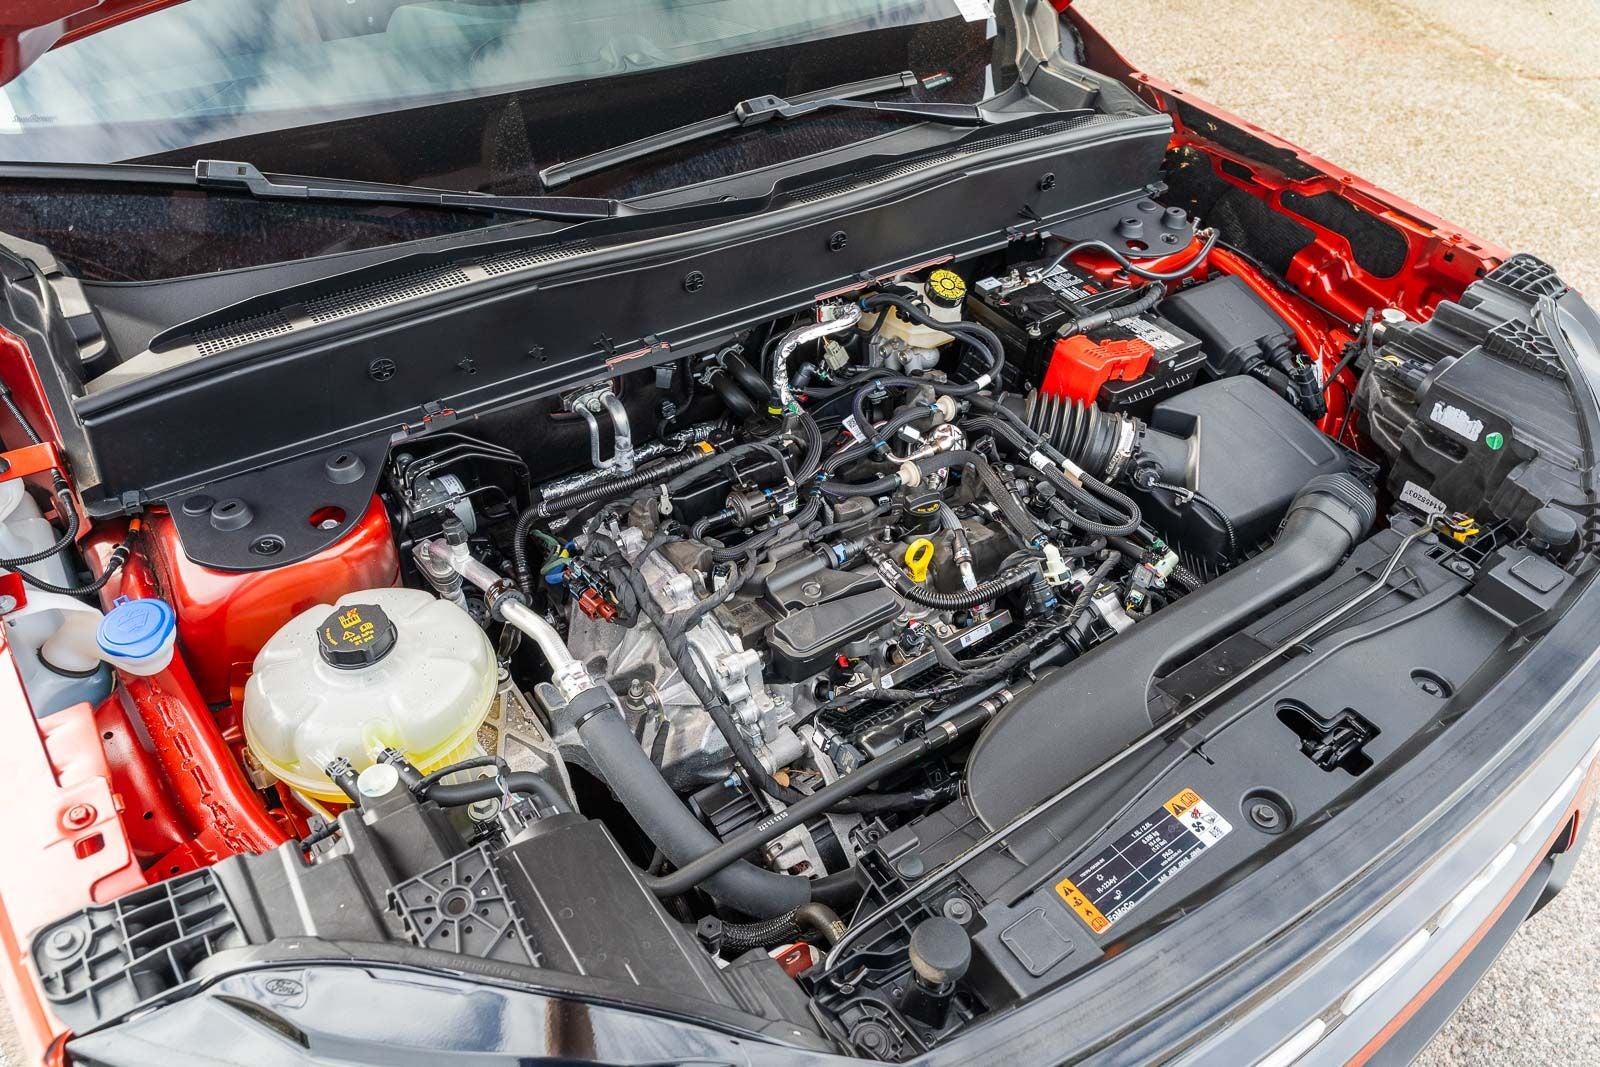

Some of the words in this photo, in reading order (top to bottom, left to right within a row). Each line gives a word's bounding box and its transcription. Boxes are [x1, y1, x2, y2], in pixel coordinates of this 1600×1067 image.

[1161, 848, 1174, 859] PAG
[1096, 876, 1118, 894] R-1234yf
[1107, 900, 1136, 923] FoMoCo
